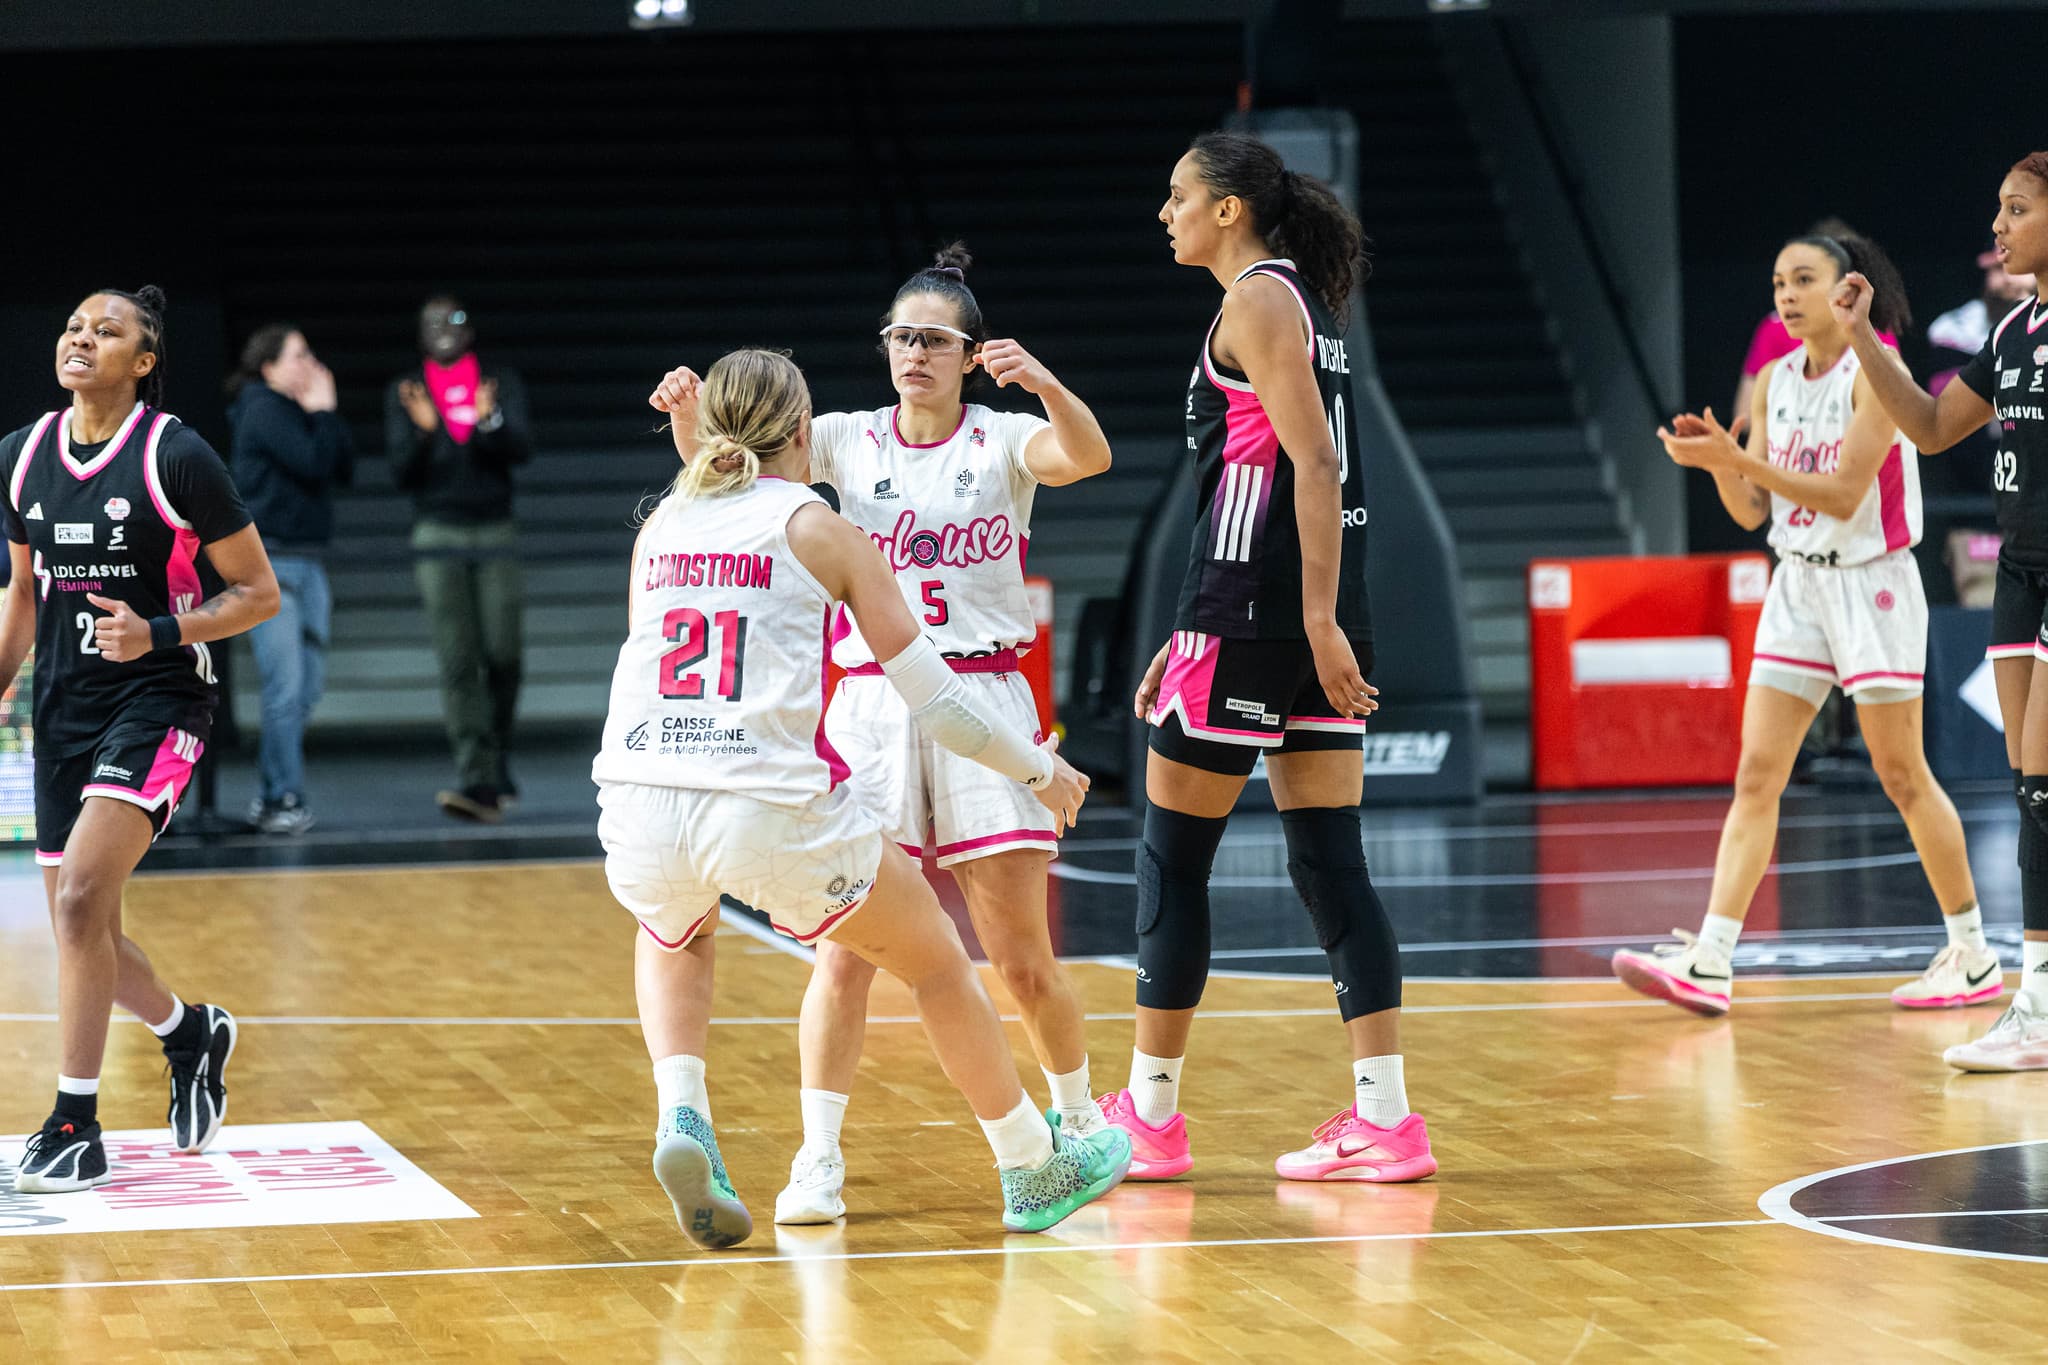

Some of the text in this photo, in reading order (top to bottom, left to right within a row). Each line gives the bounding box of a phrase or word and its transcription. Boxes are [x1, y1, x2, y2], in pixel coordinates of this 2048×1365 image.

[1327, 393, 1349, 484] 0
[870, 509, 1013, 572] ulouse
[53, 564, 138, 578] LDLC ASVEL
[645, 553, 773, 592] LINDSTROM
[56, 581, 102, 592] FÉMININ
[920, 579, 949, 627] 5
[658, 608, 748, 702] 21
[661, 728, 745, 743] D'EPARGNE
[662, 716, 717, 730] CAISSE
[658, 741, 758, 758] de Midi-Pyrénées
